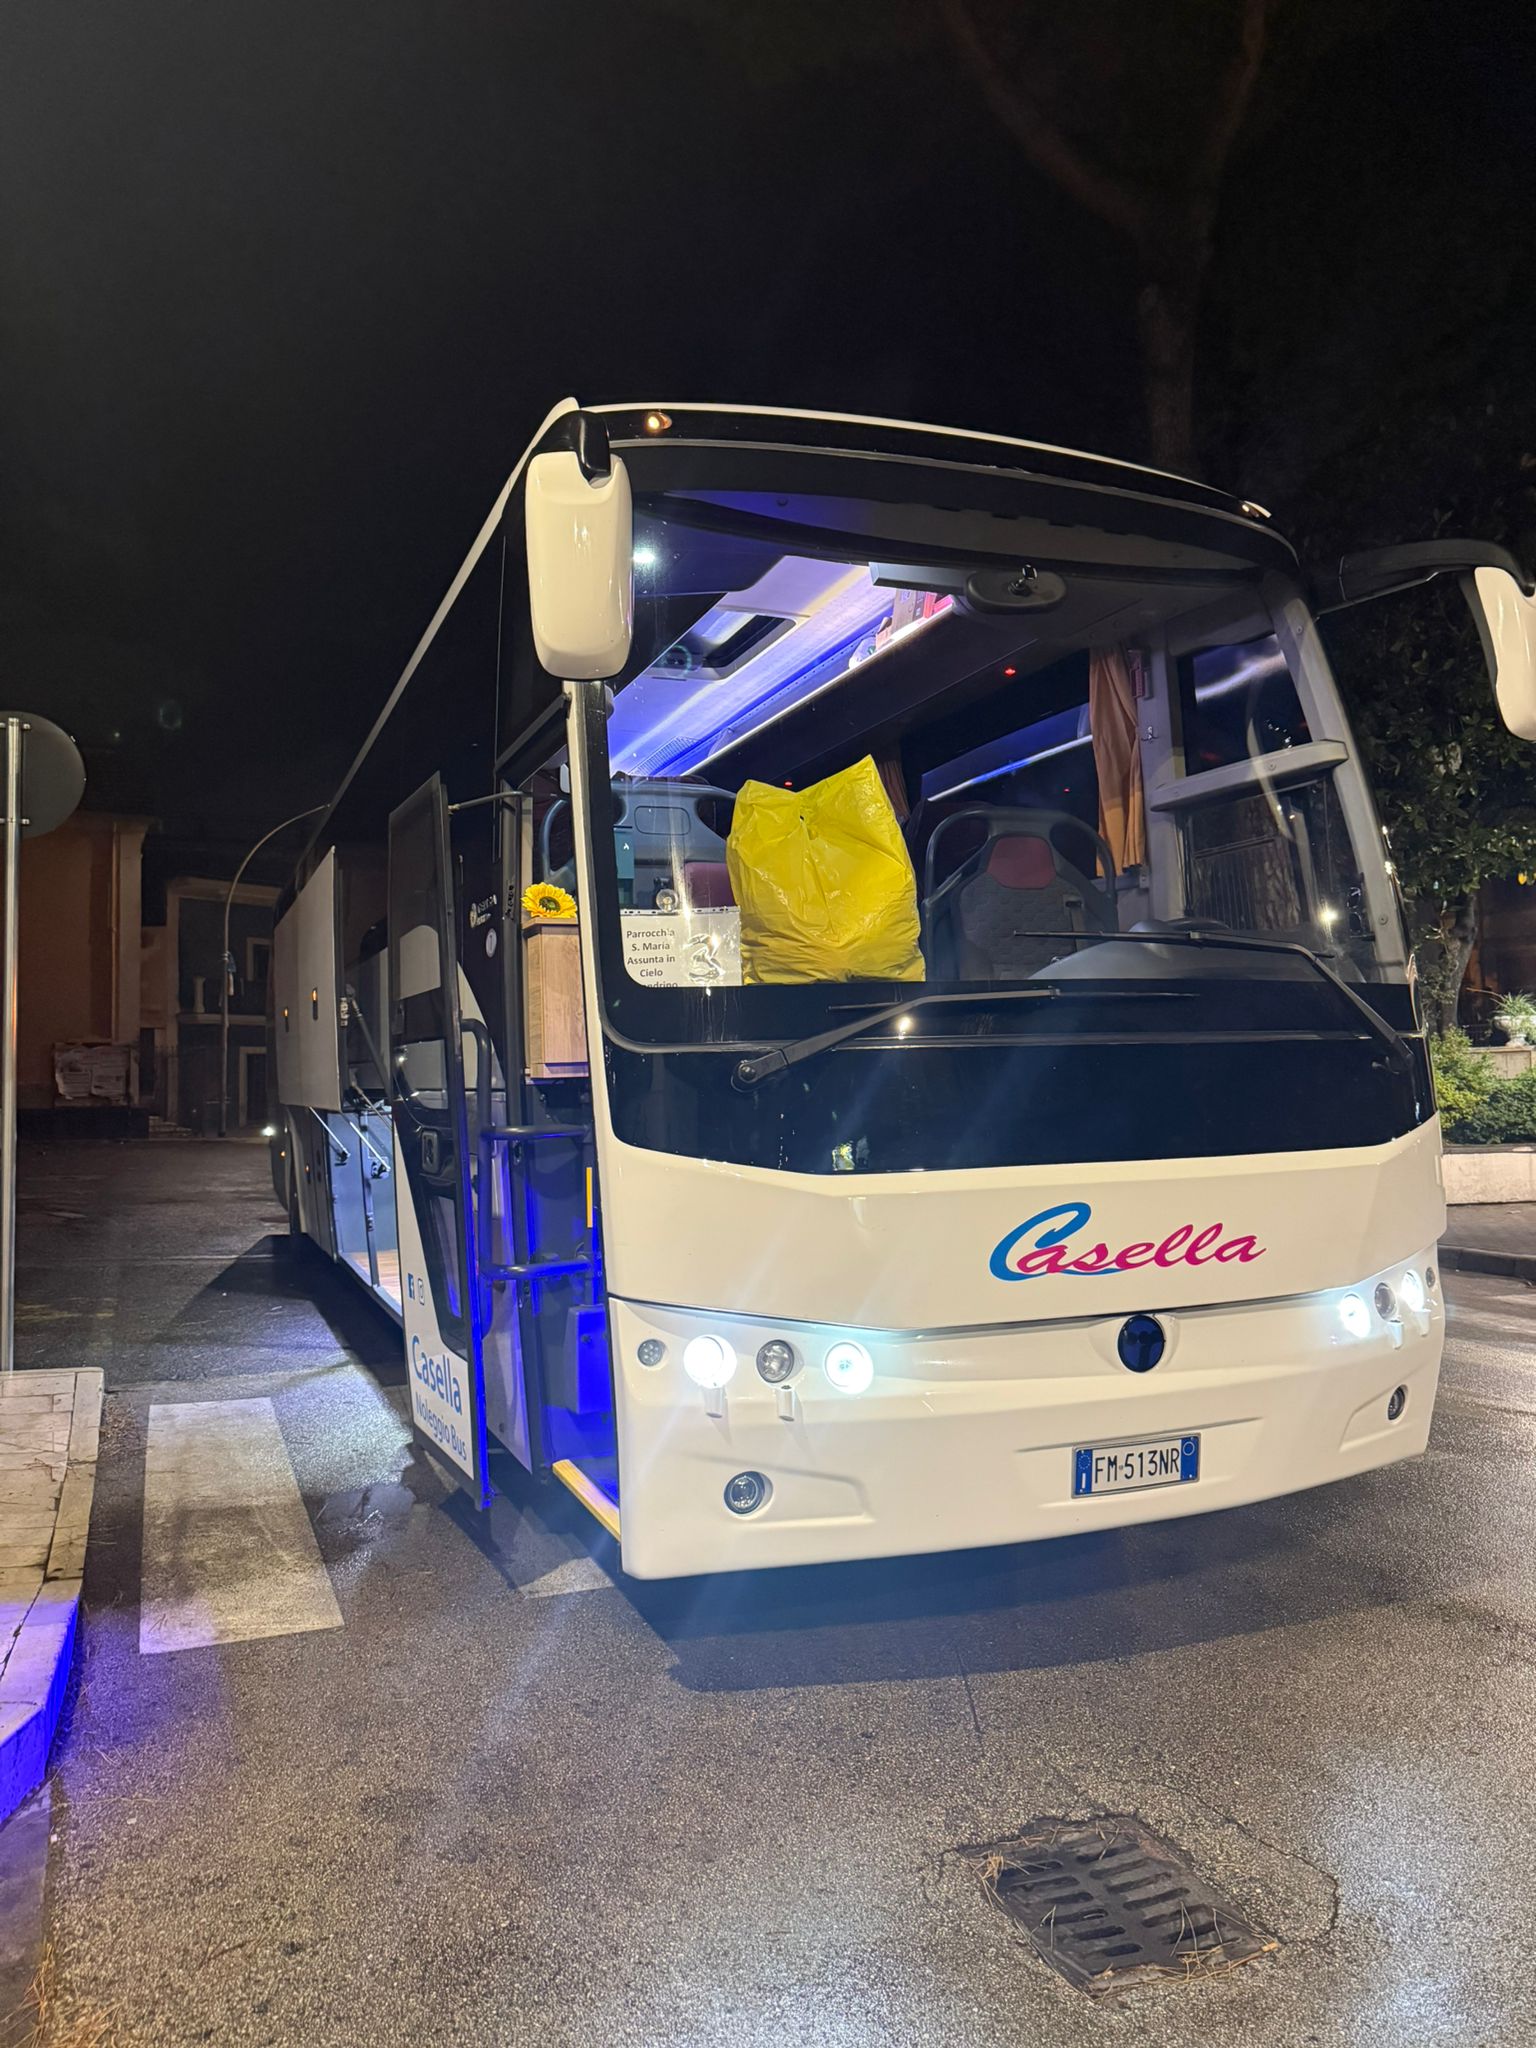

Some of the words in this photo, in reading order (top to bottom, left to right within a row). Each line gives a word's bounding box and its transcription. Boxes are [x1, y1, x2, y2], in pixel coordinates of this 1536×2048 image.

[627, 956, 664, 965] Assunta
[666, 954, 676, 963] in
[631, 943, 640, 952] S.
[642, 941, 671, 951] Maria
[639, 968, 663, 977] Cielo
[989, 1201, 1267, 1281] Casella
[412, 1335, 462, 1416] Casella
[415, 1391, 450, 1444] Noleggio
[450, 1423, 467, 1461] Bus
